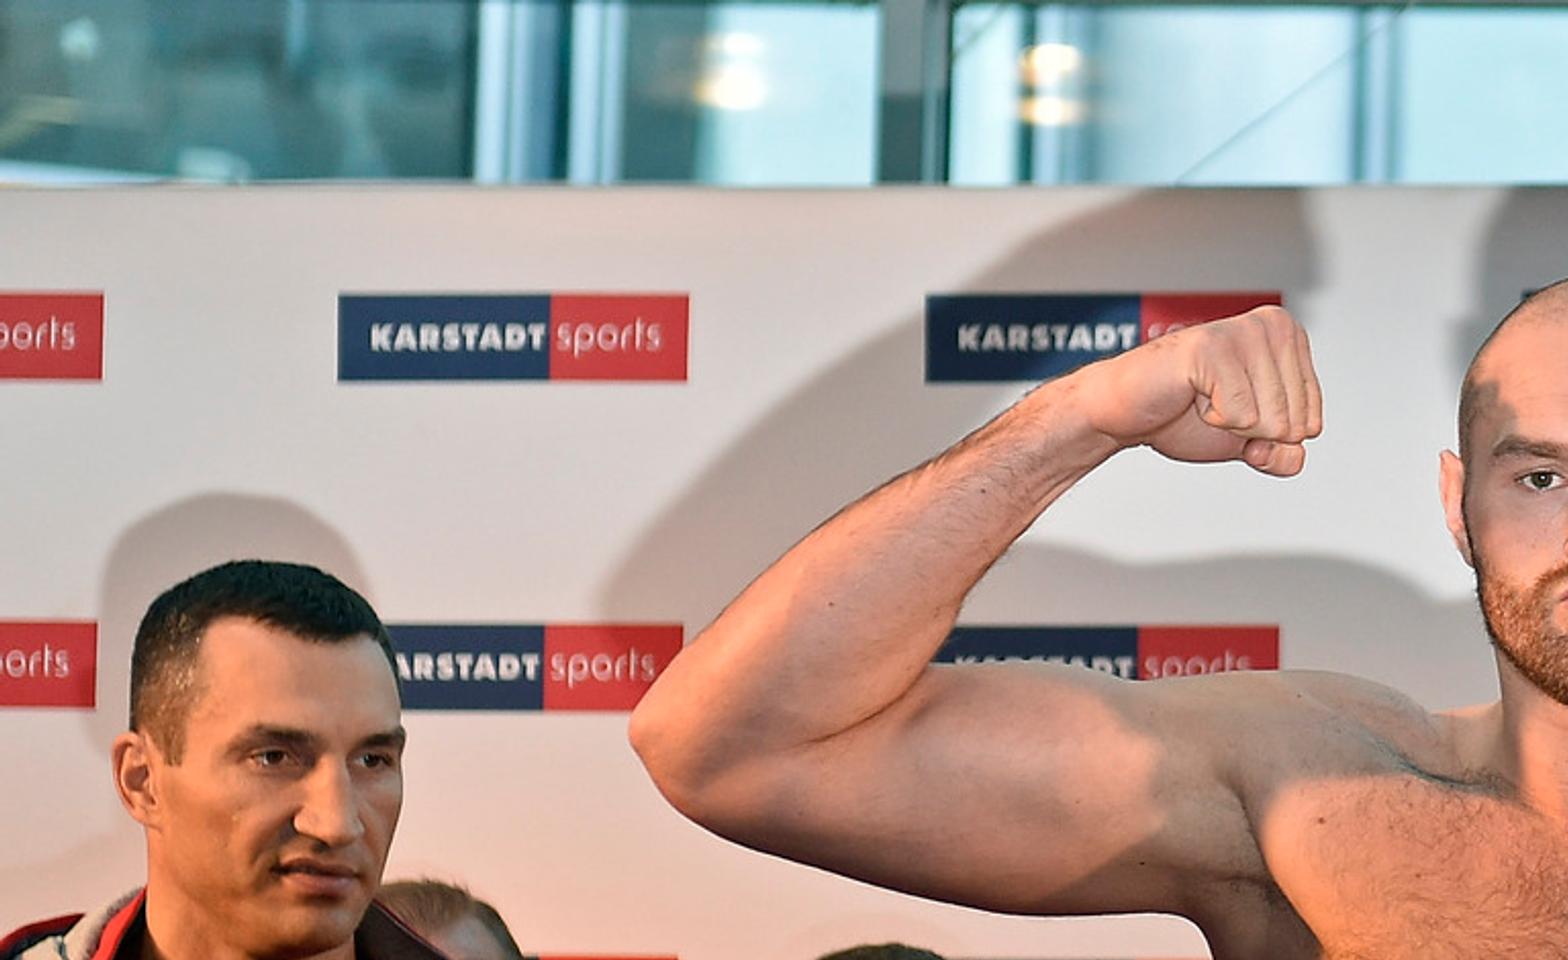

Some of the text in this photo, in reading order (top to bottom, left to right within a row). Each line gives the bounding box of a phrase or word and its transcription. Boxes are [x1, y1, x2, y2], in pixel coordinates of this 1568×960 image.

[0, 314, 76, 351] orts
[370, 315, 661, 358] KARSTADT sports
[956, 322, 1137, 352] KARSTADT
[0, 642, 70, 678] orts
[395, 647, 656, 689] ARSTADT sports
